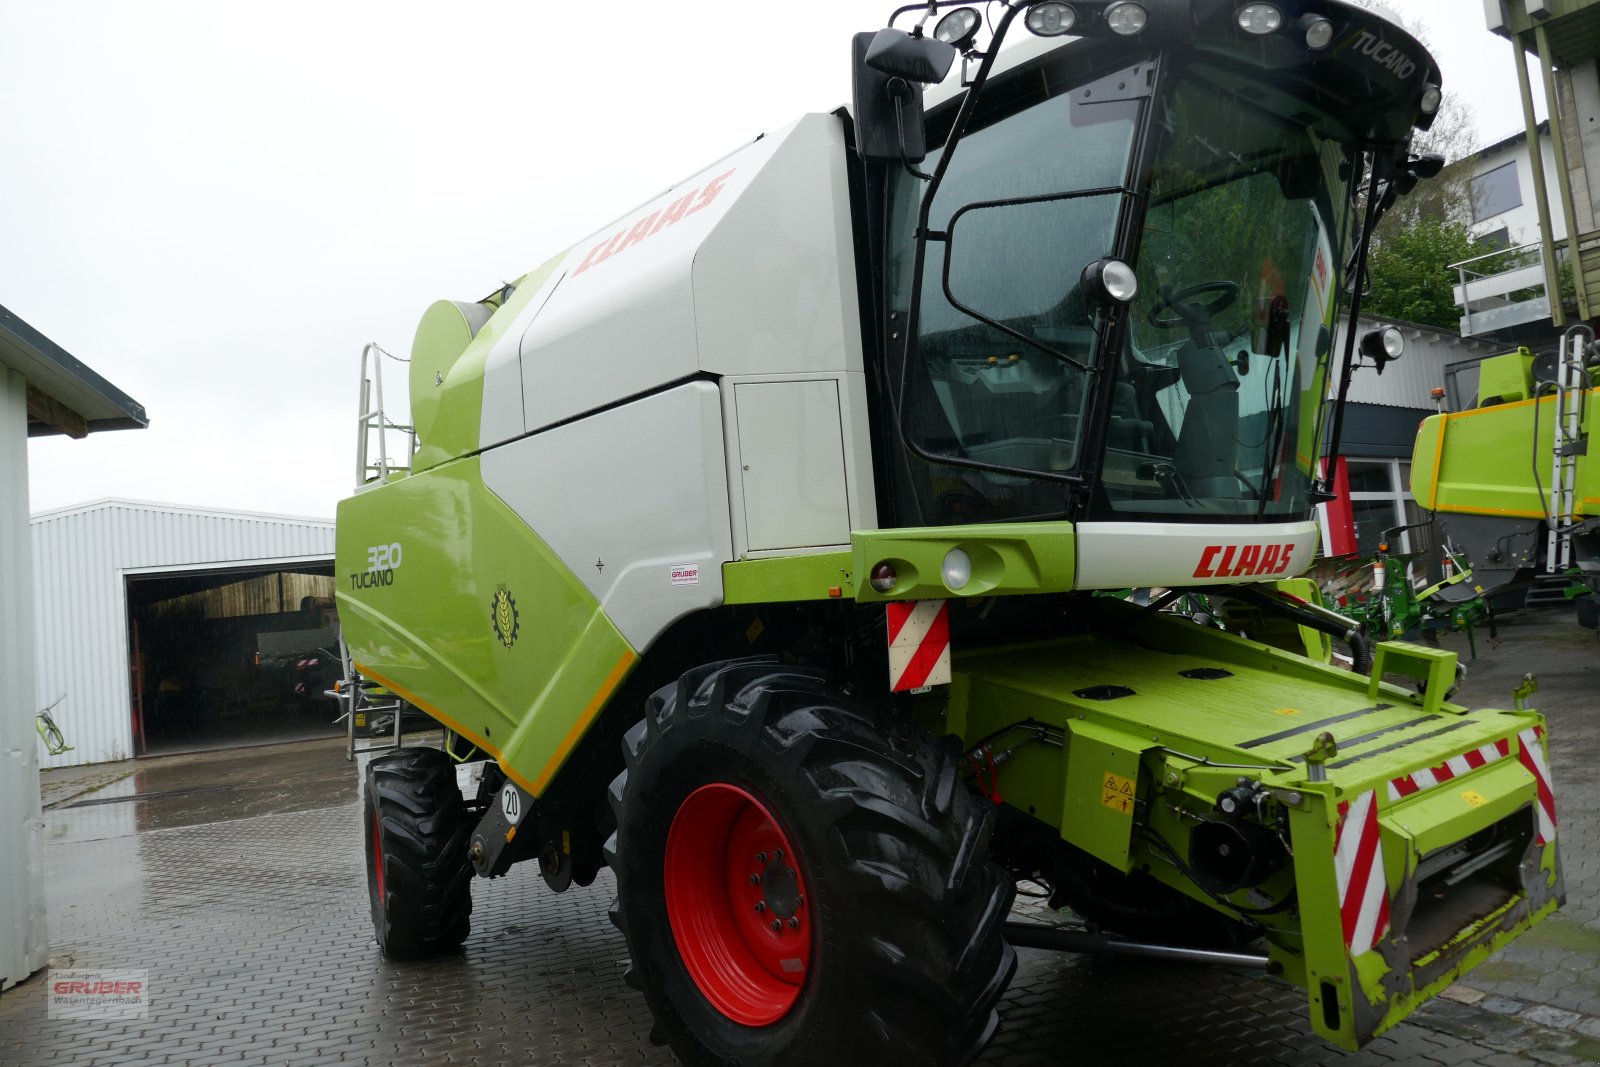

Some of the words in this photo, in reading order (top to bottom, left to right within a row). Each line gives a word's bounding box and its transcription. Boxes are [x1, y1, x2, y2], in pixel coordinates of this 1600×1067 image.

[1352, 31, 1416, 79] TUCANO
[571, 168, 737, 278] CLAAS
[367, 542, 402, 573] 320
[1192, 543, 1295, 578] CLAAS
[350, 568, 394, 590] TUCANO
[671, 569, 698, 578] GRUBER
[504, 789, 518, 816] 20
